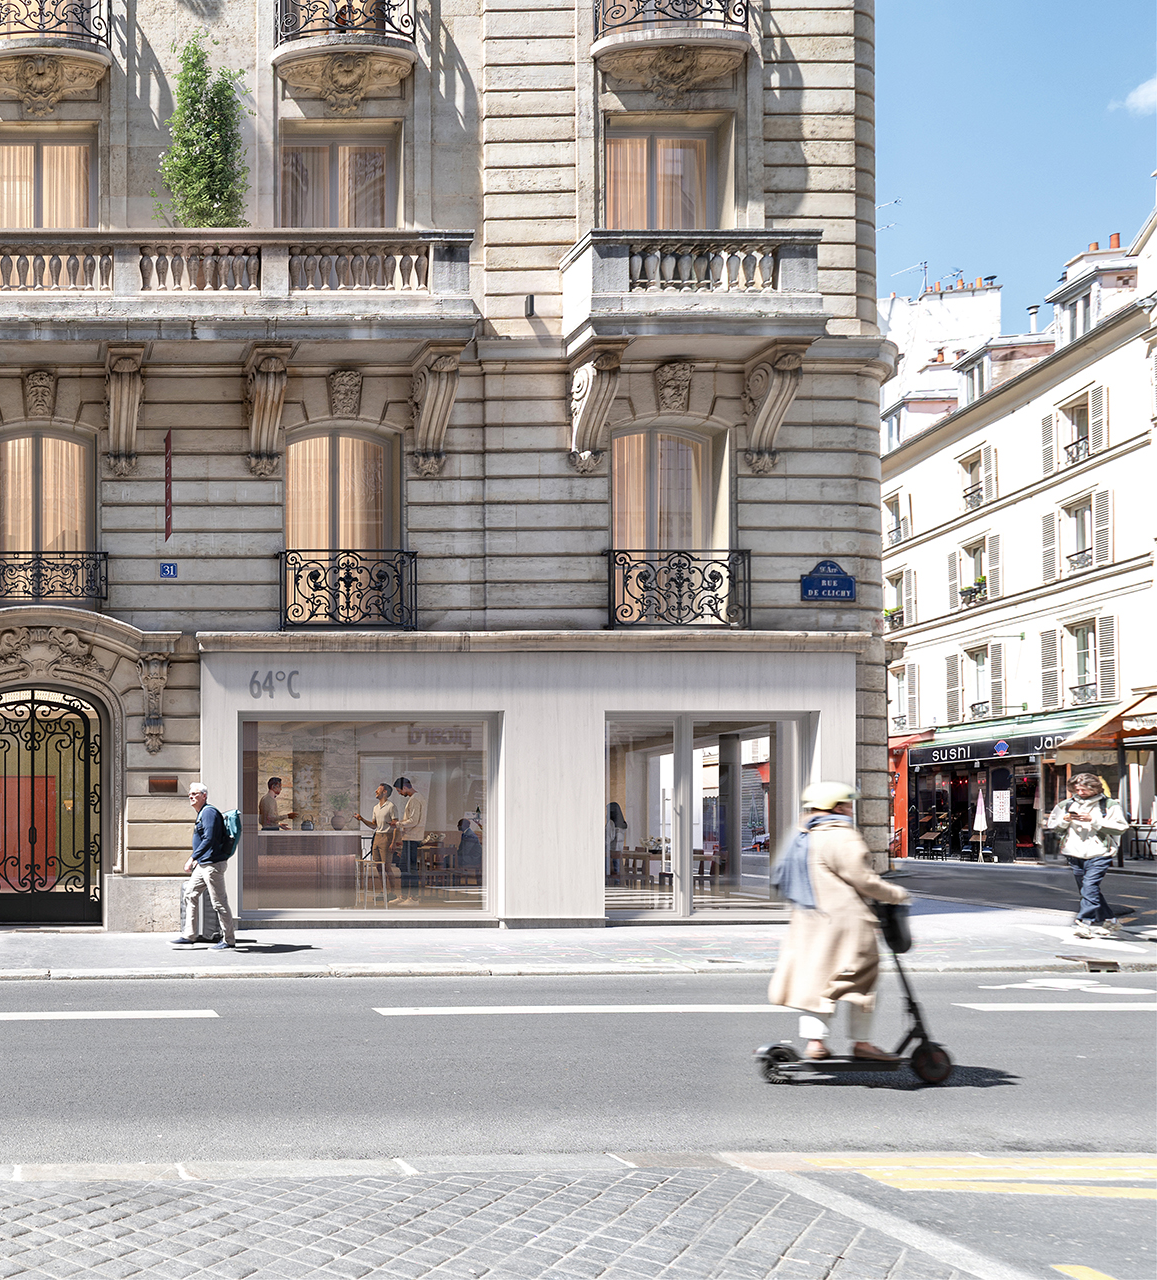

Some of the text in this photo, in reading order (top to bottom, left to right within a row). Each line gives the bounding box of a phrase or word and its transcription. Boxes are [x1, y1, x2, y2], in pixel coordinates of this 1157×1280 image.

[163, 565, 174, 576] 31
[249, 670, 301, 699] 64°C
[932, 745, 971, 762] sushi
